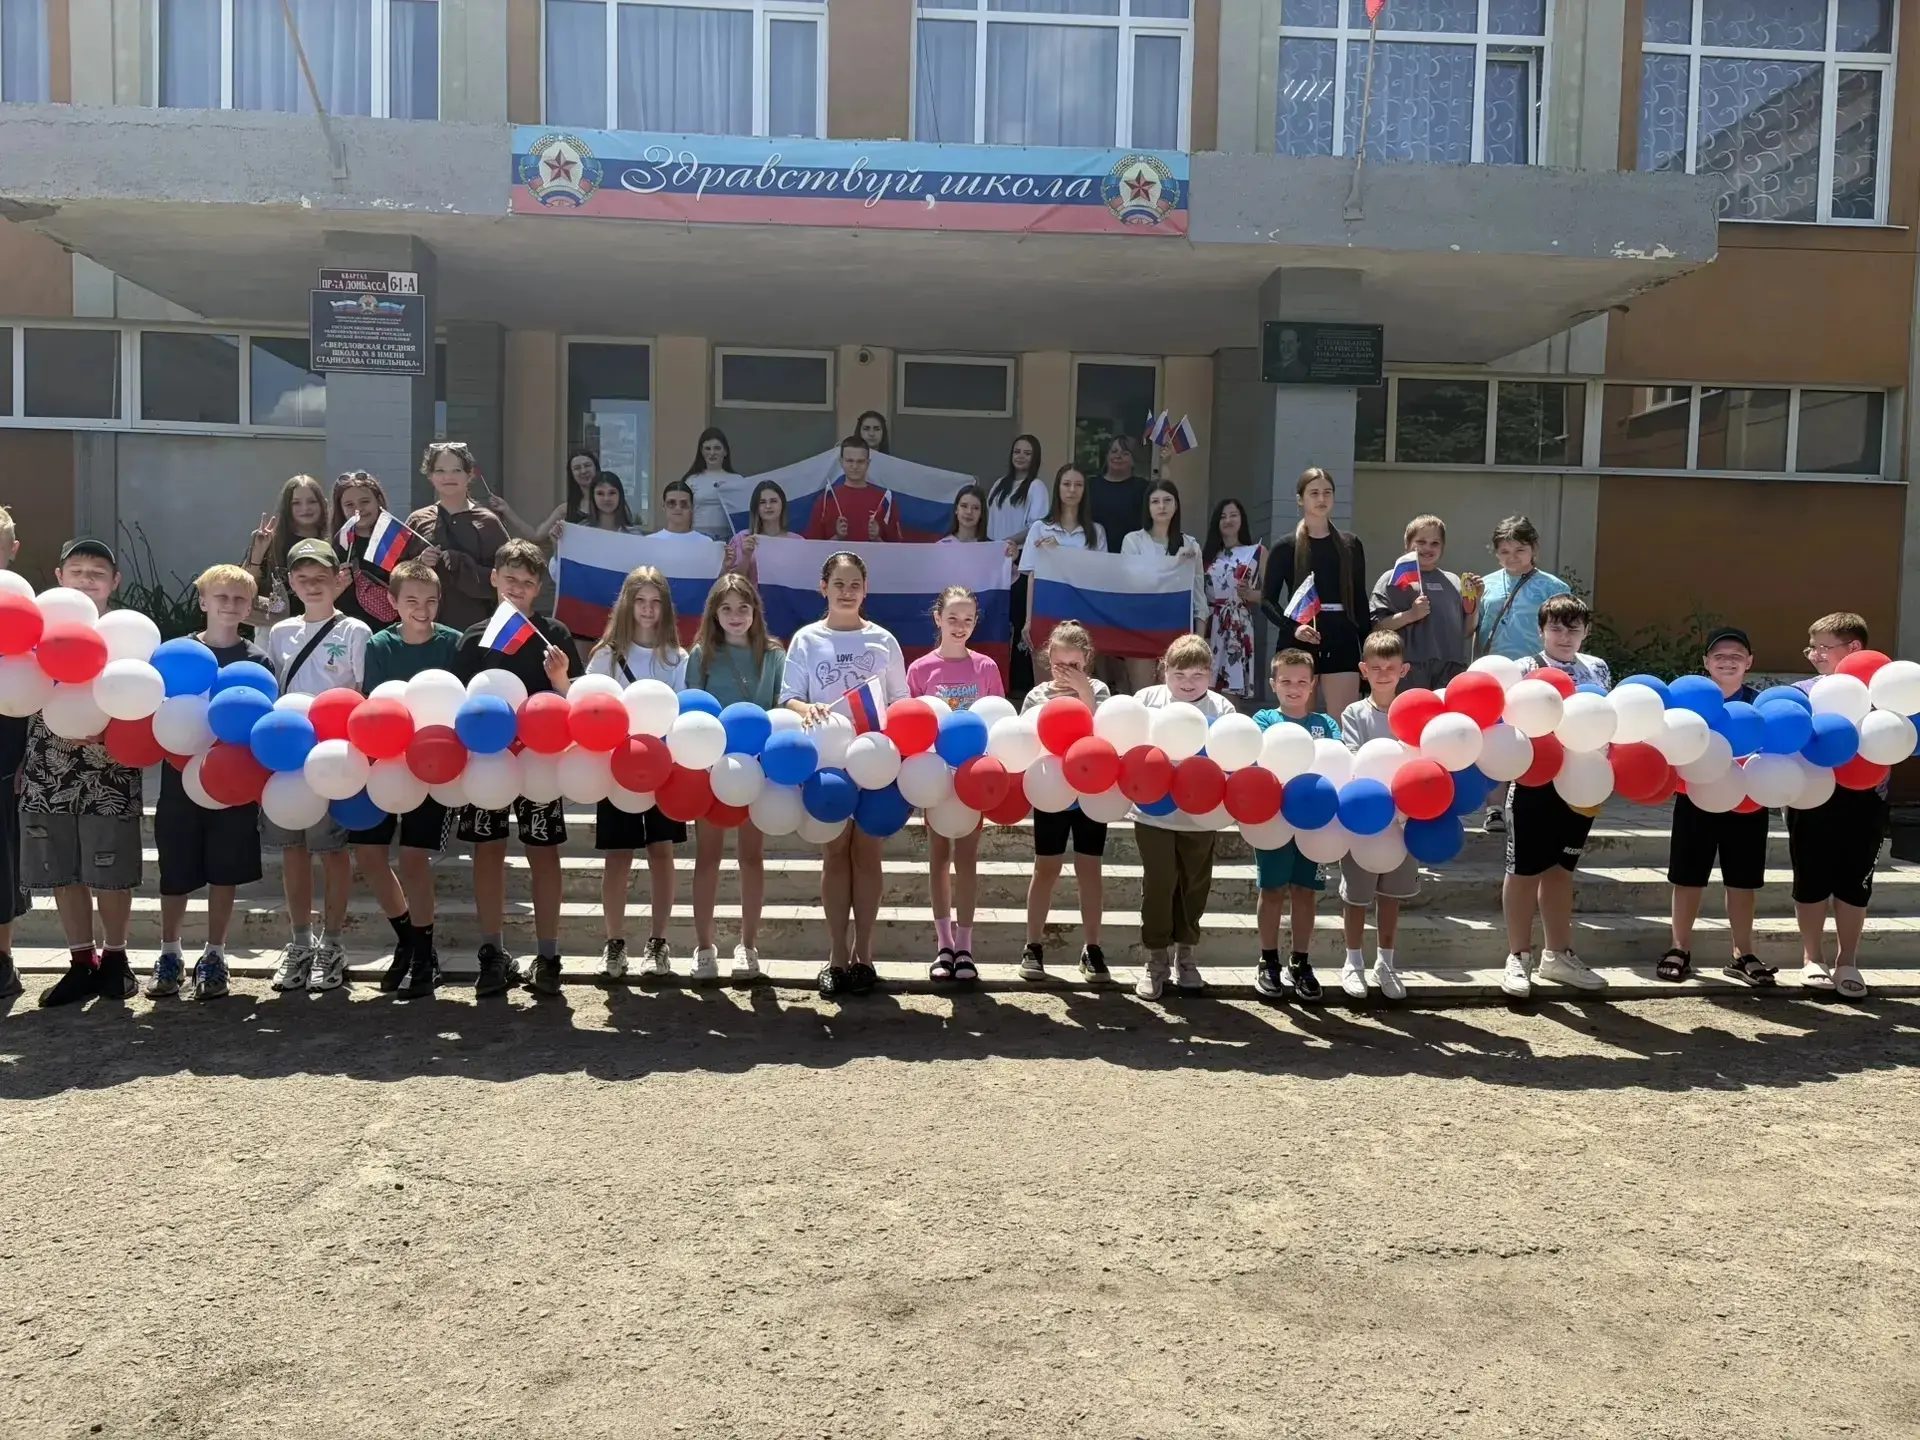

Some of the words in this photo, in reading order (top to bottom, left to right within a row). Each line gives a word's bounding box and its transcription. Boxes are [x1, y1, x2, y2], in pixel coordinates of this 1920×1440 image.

[940, 173, 1094, 199] школа
[345, 280, 387, 291] ДОНБАССА
[382, 343, 416, 352] СРЕДНЯЯ
[332, 349, 360, 357] ШКОЛА
[377, 351, 405, 359] ИМЕНИ
[316, 355, 368, 365] СТАНИСЛАВА
[836, 653, 854, 663] LOVE
